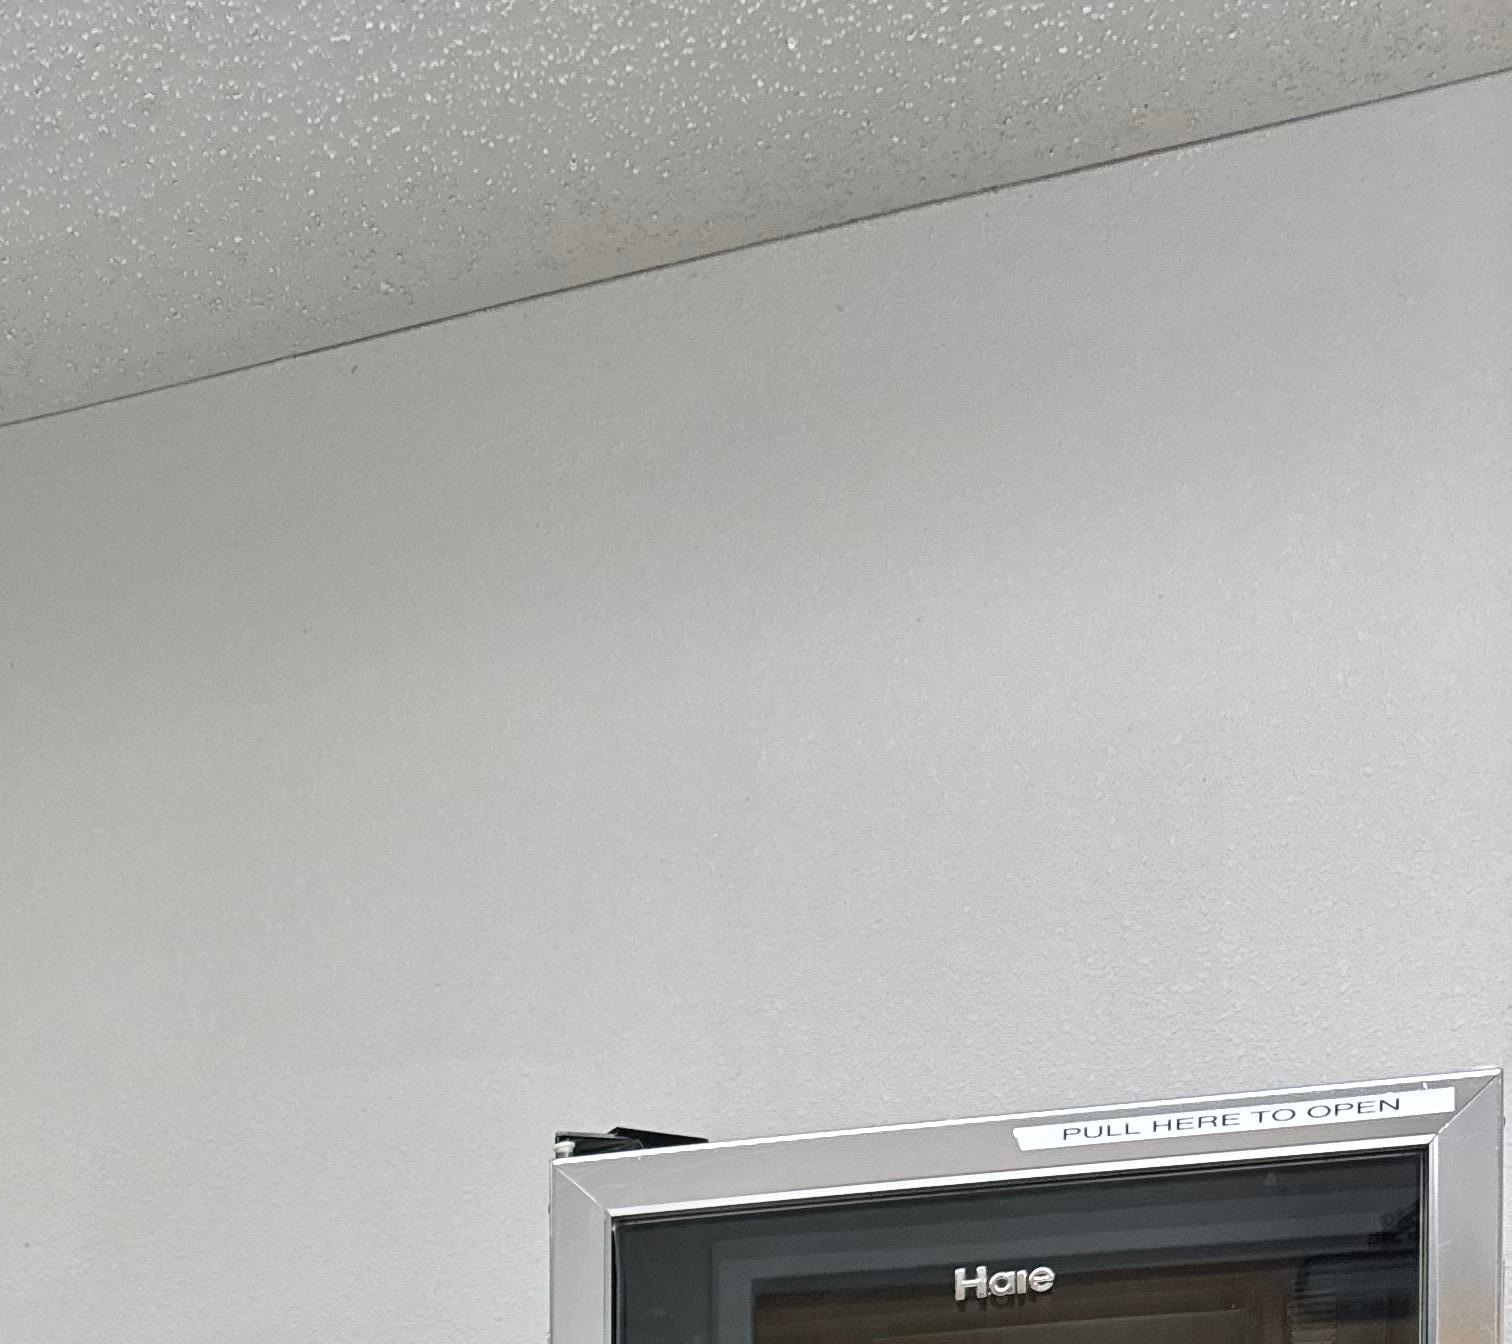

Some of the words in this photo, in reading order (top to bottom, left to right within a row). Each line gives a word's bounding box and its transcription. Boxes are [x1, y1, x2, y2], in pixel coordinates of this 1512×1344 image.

[1062, 1122, 1141, 1141] PULL
[1152, 1112, 1242, 1133] HERE
[1250, 1108, 1297, 1123] TO
[1306, 1098, 1401, 1119] OPEN
